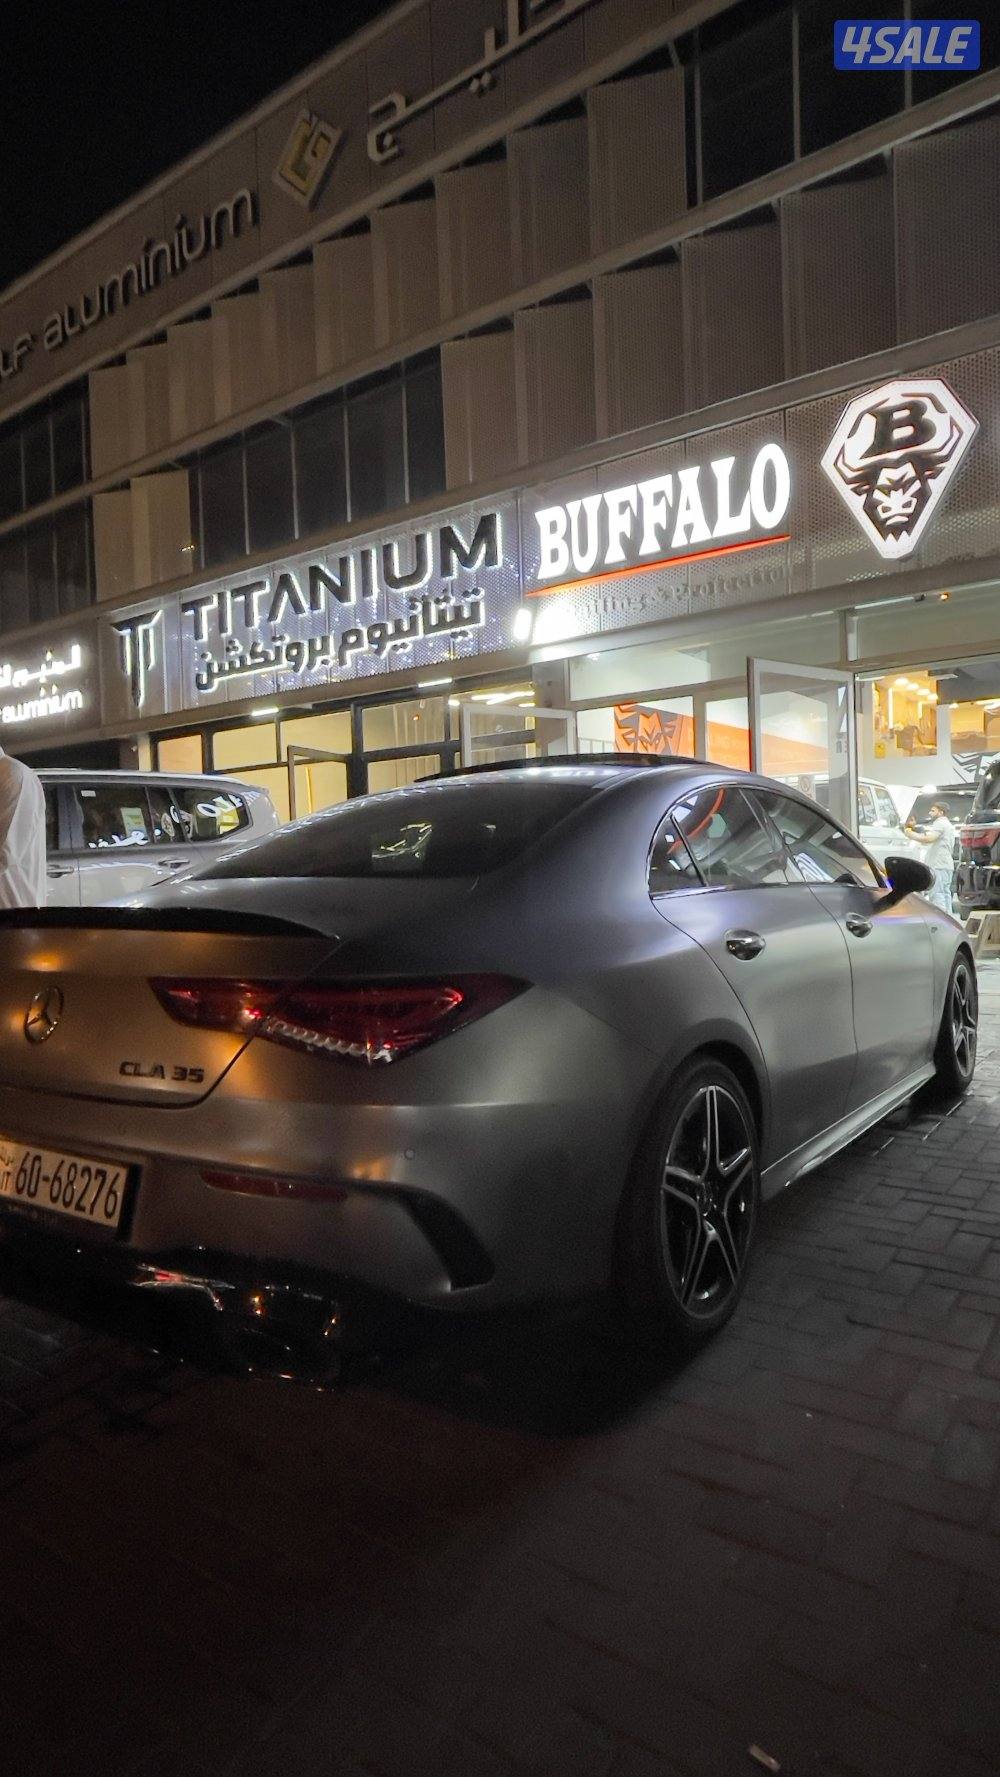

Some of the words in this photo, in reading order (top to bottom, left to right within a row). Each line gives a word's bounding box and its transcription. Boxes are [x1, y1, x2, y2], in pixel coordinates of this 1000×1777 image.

[534, 443, 791, 580] BUFFALO
[181, 512, 502, 641] TITANIUM
[119, 1061, 166, 1080] CLA
[171, 1066, 205, 1083] 35
[15, 1151, 120, 1219] 60-68276
